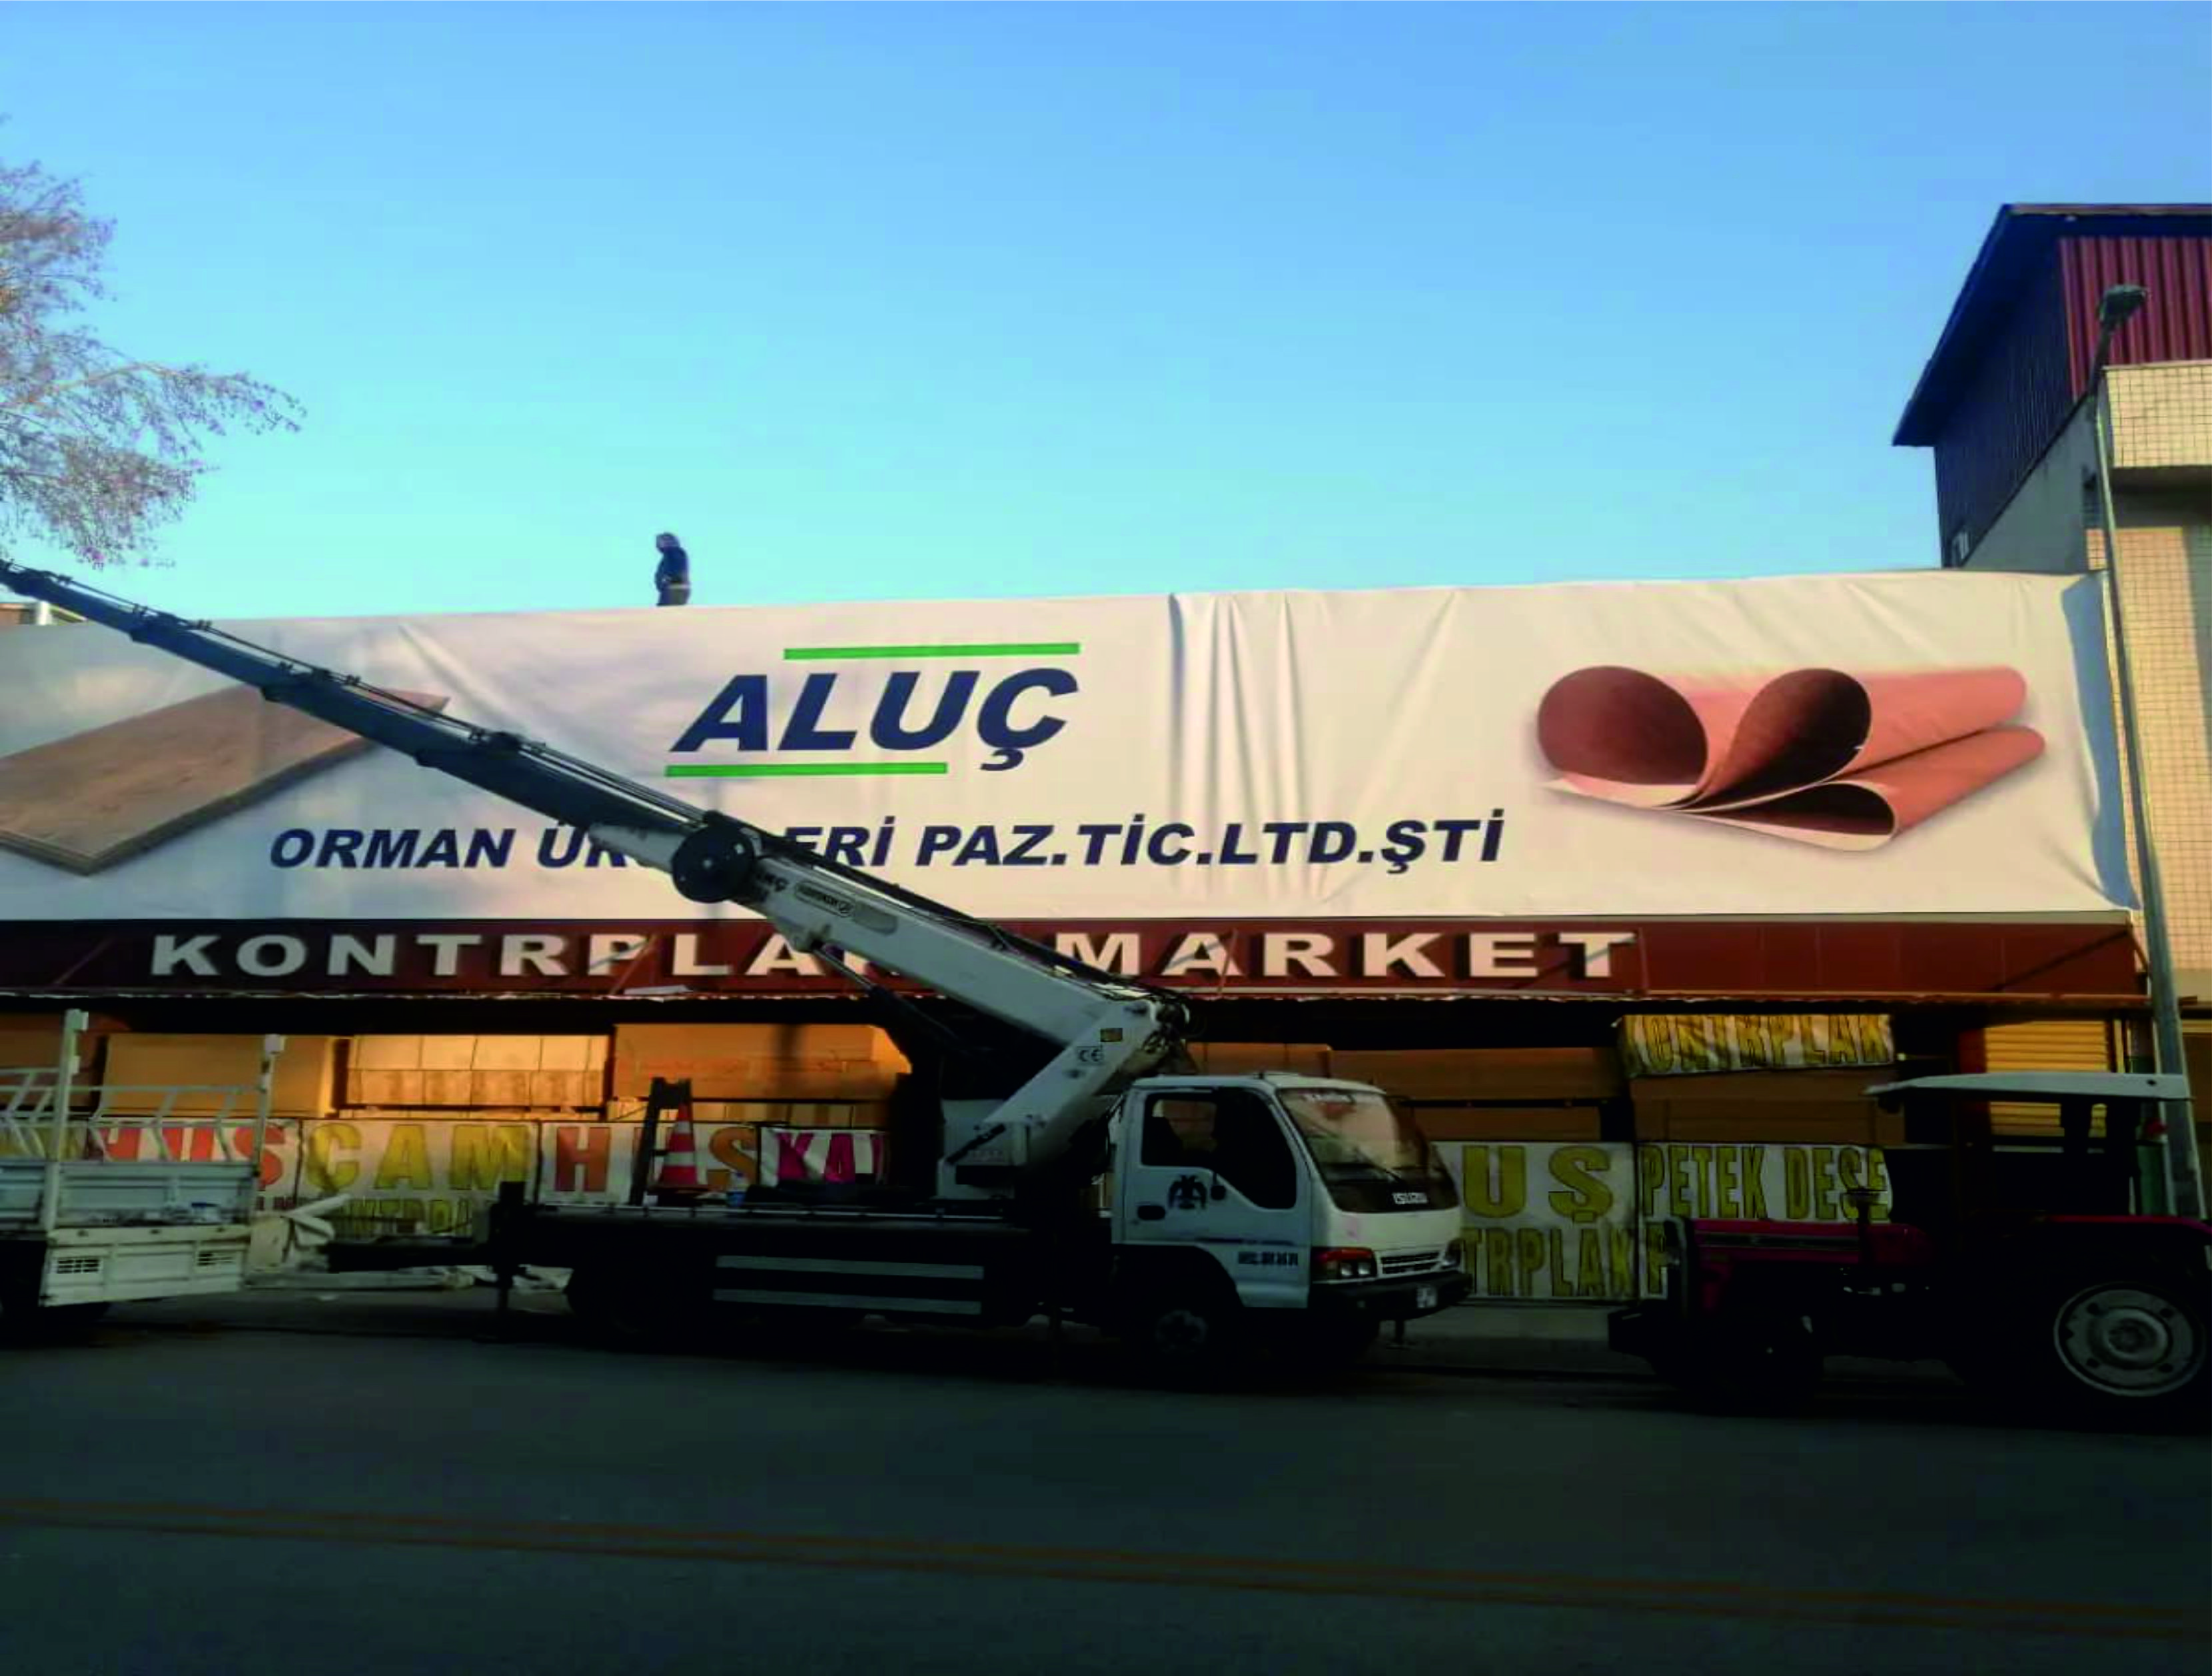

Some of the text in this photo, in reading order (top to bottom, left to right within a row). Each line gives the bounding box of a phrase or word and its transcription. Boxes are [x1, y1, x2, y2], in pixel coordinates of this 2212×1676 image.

[668, 667, 1080, 772] ALUÇ
[270, 828, 517, 868] ORMAN
[1055, 932, 1636, 978] MARKET
[307, 1123, 528, 1191] CAM
[1642, 1146, 1768, 1220] PETEK
